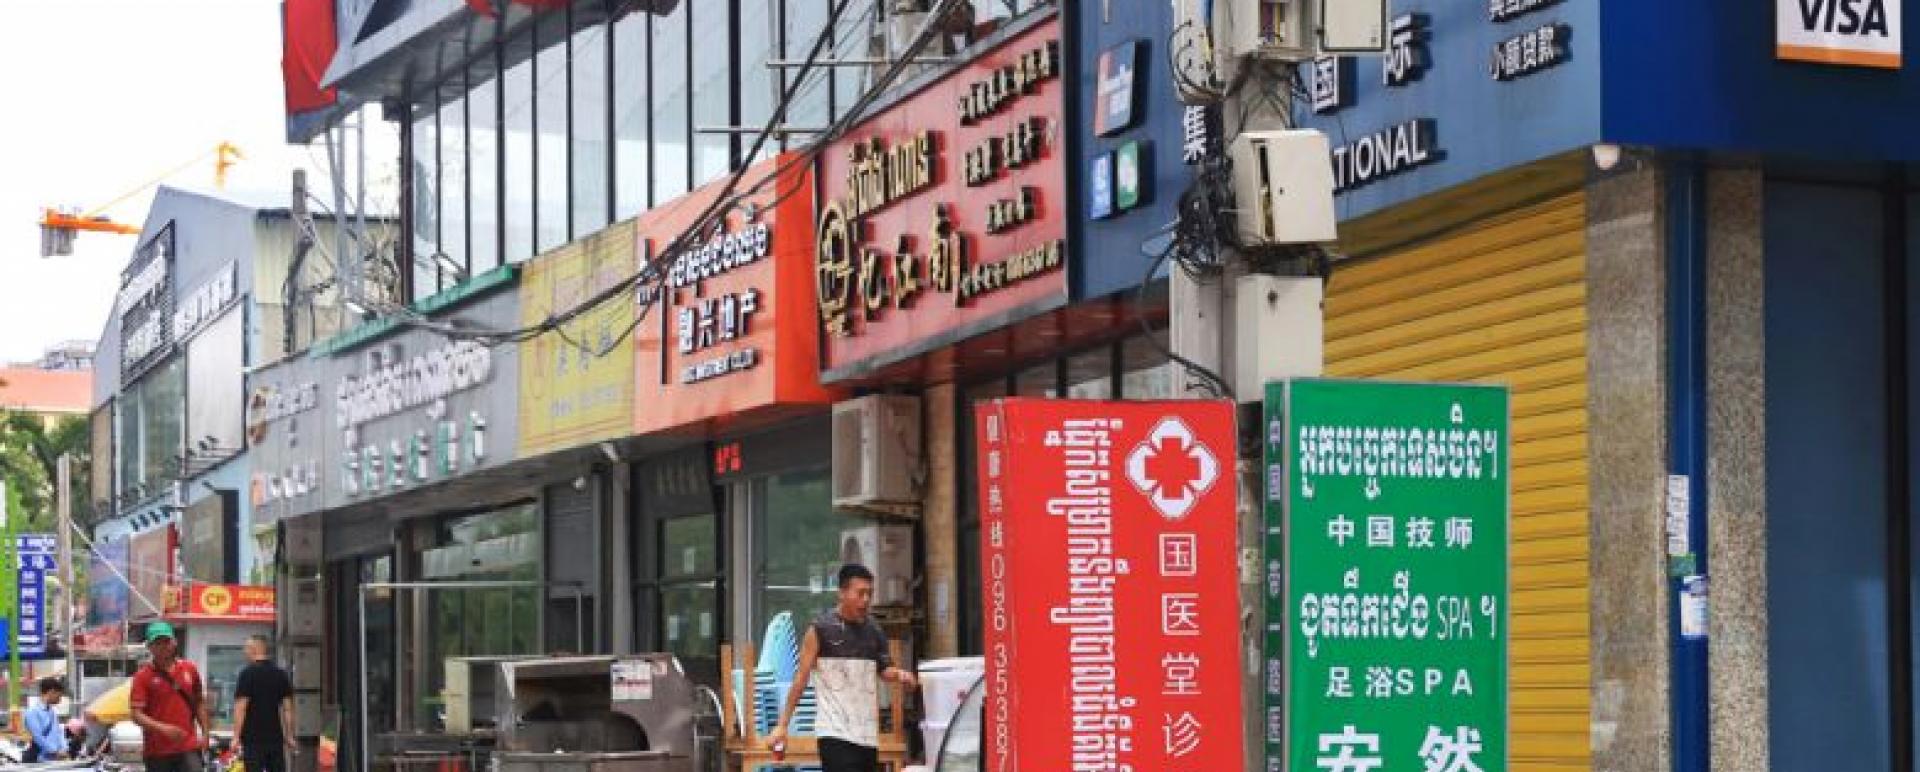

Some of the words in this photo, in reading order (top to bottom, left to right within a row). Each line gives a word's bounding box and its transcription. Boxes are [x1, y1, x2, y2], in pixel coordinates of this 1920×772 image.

[1799, 0, 1889, 37] VISA
[1326, 514, 1473, 548] 中国技师
[1436, 595, 1473, 641] SPA
[1158, 533, 1201, 757] 国医堂诊
